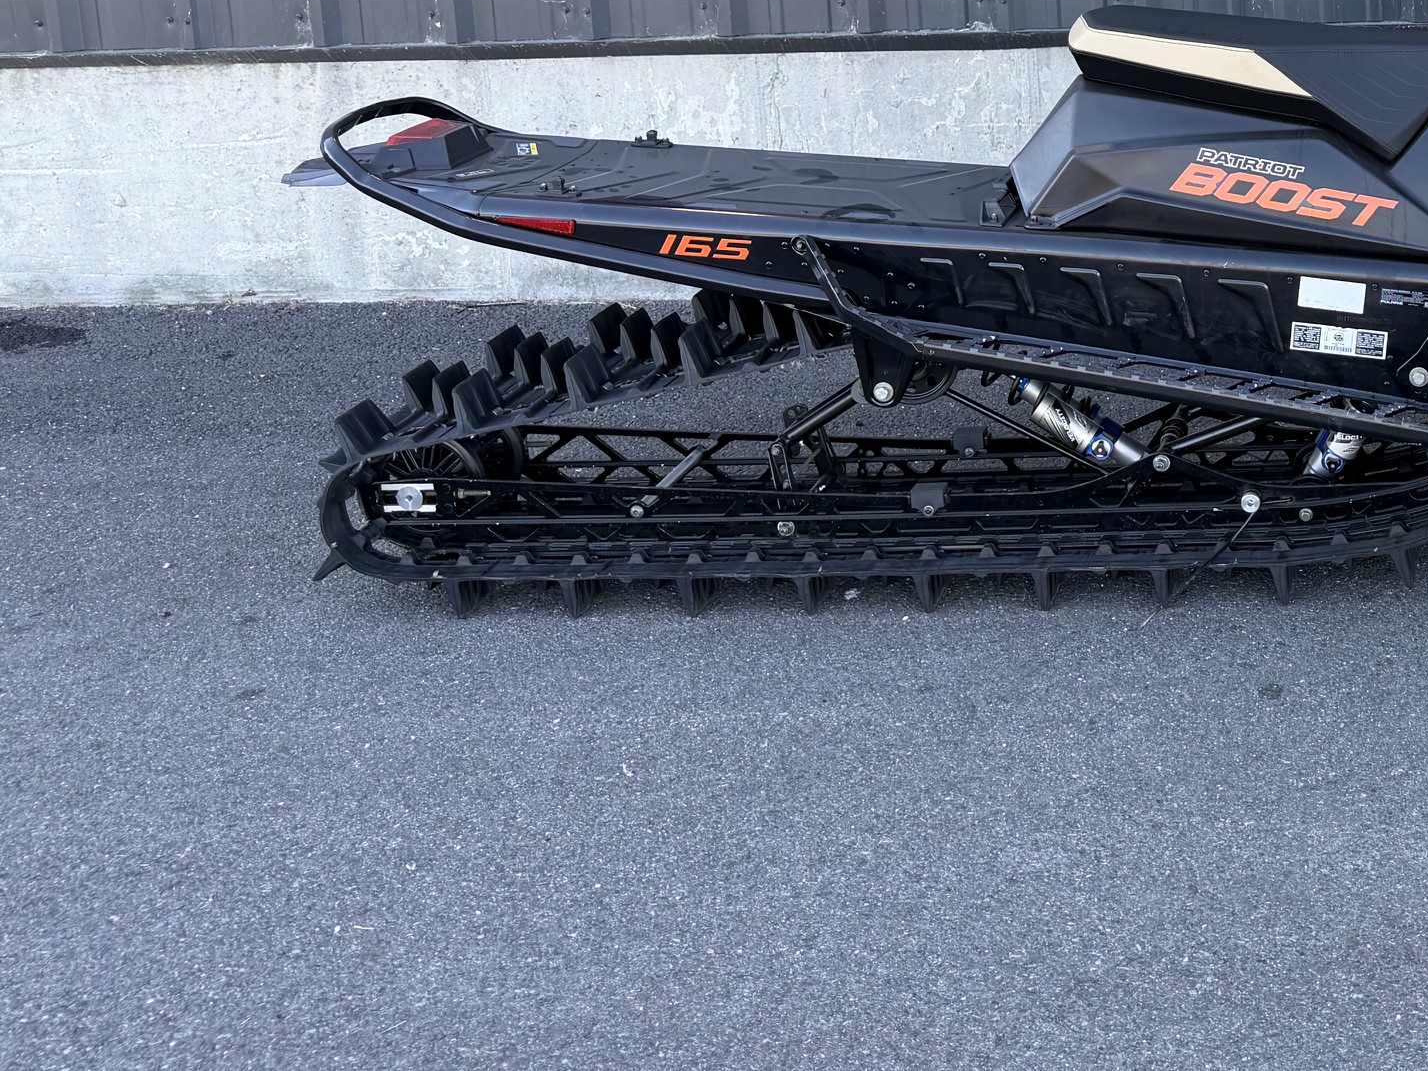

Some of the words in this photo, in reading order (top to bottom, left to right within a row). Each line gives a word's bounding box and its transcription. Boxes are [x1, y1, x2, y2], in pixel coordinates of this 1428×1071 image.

[1196, 147, 1305, 179] PATRIOT
[1169, 162, 1399, 227] BOOST
[659, 234, 753, 261] 165
